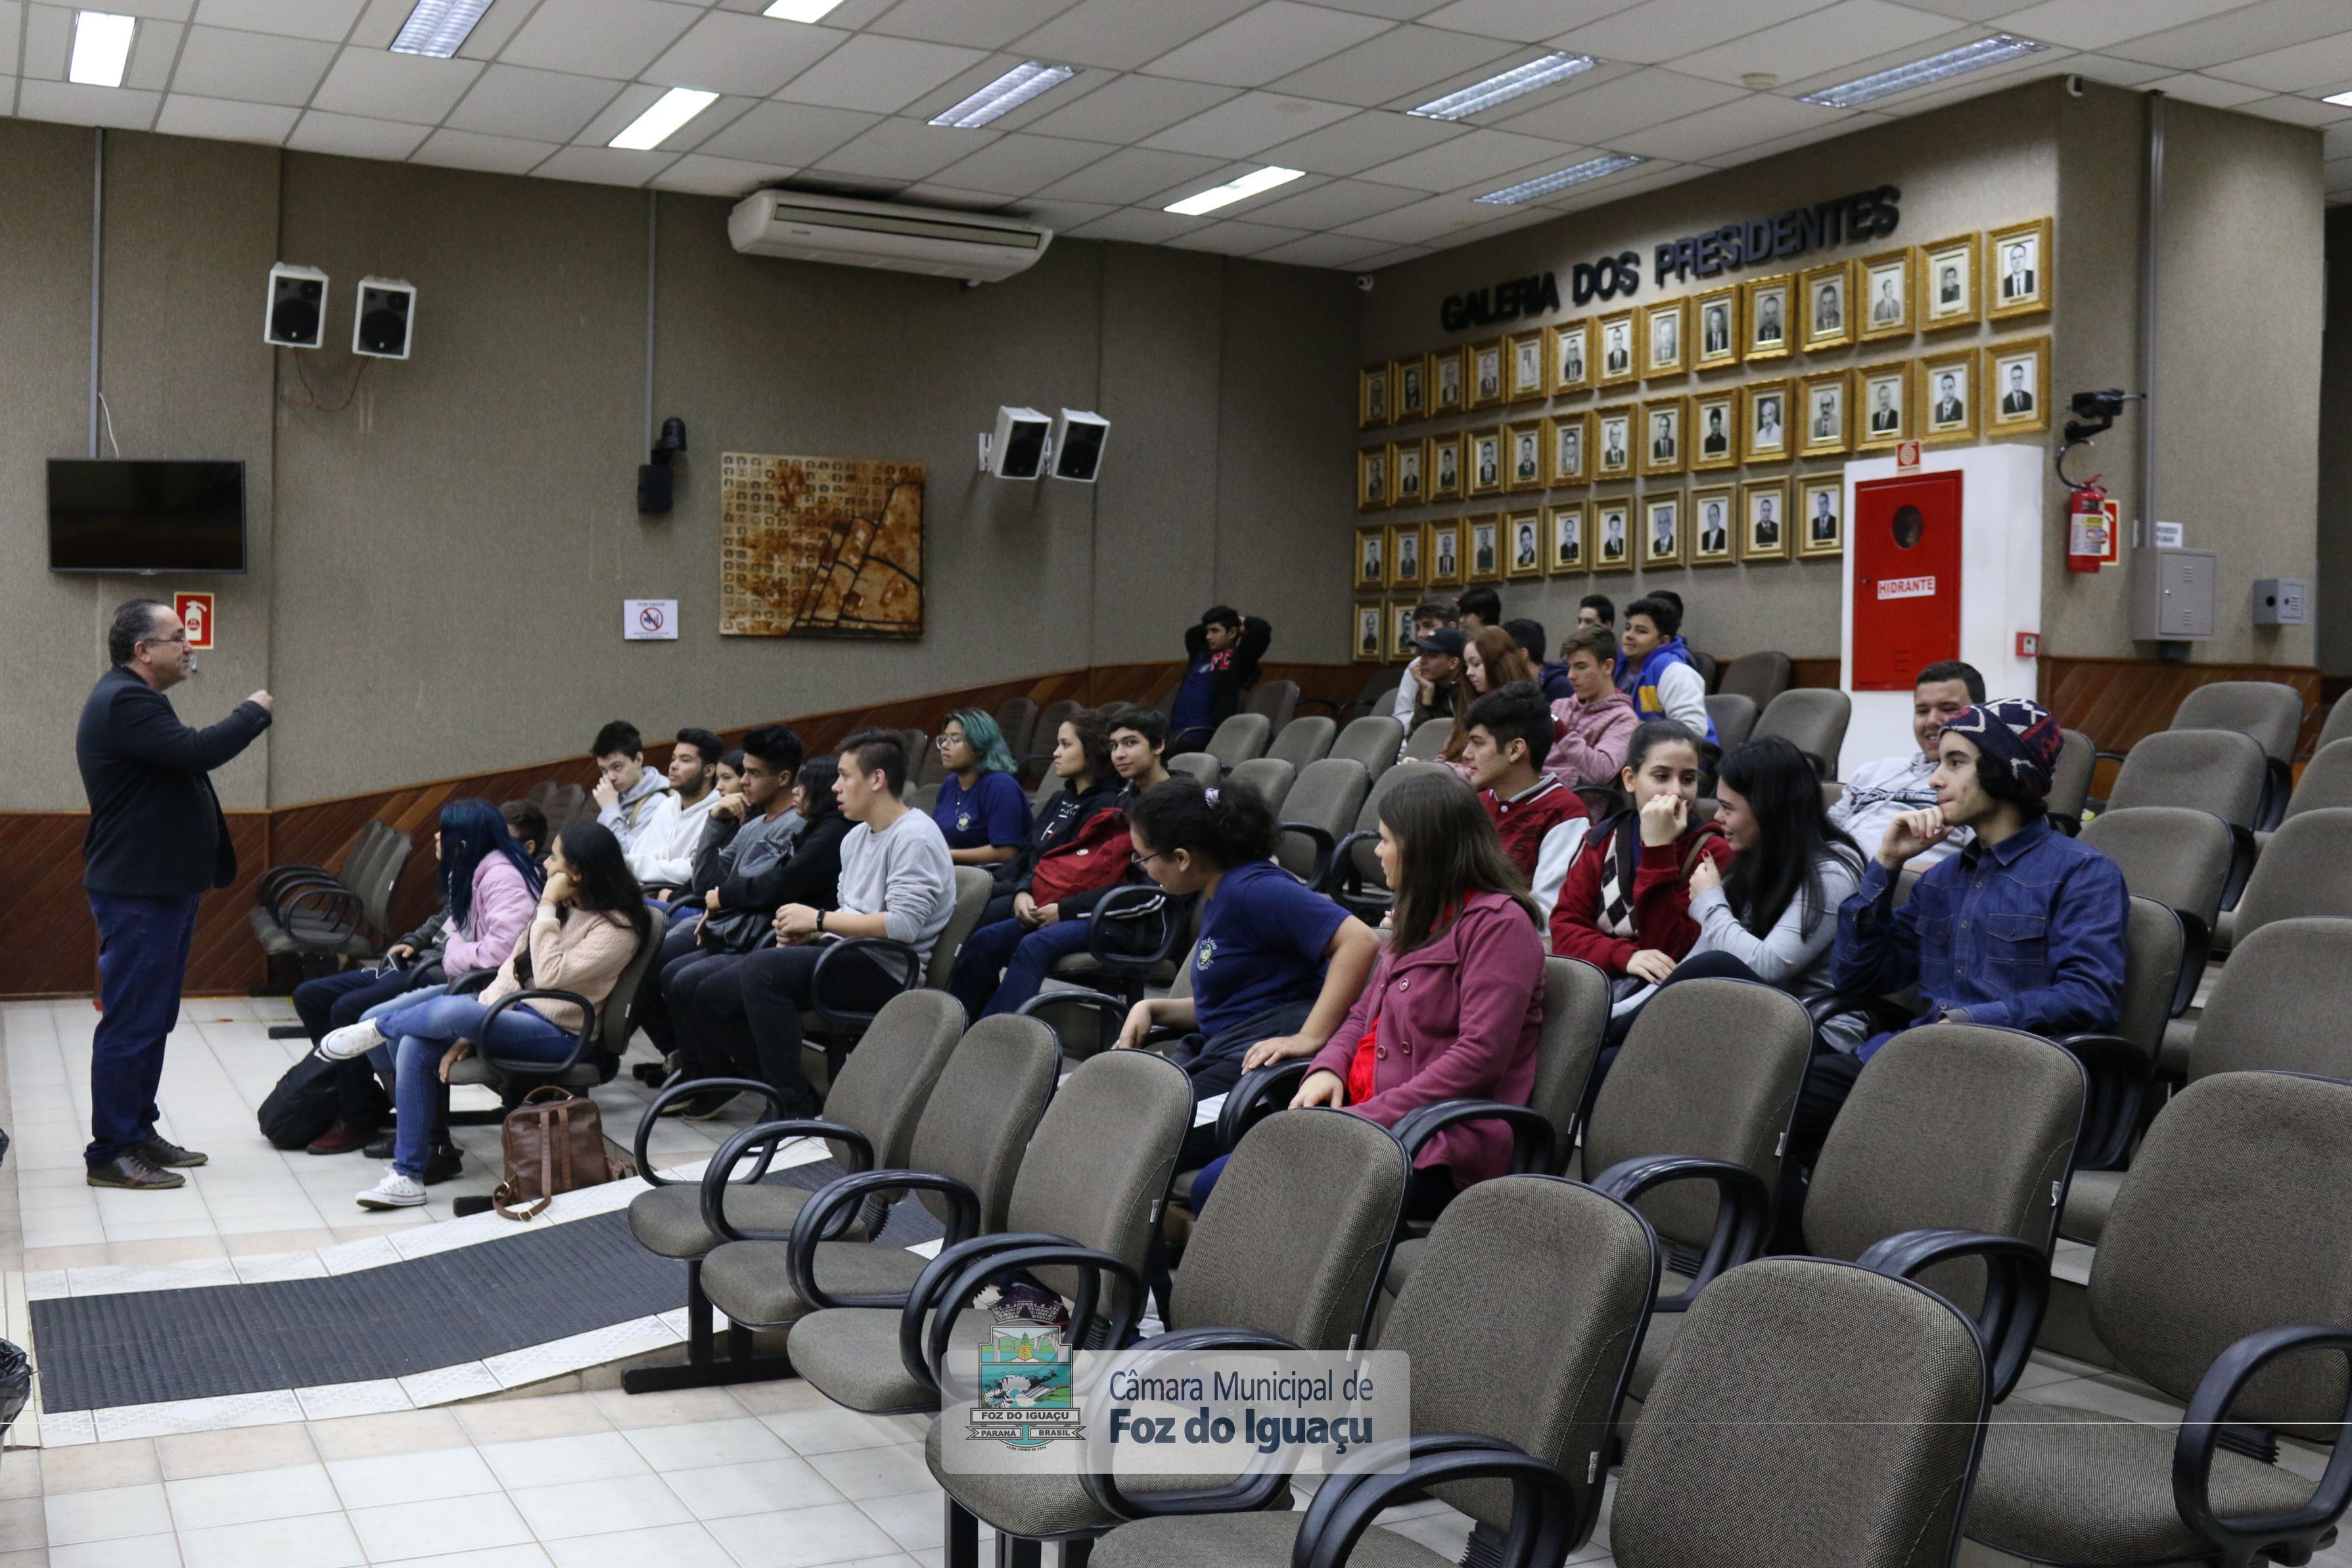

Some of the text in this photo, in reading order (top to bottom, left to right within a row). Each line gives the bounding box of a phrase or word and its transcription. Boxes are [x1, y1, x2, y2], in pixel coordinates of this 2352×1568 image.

[1441, 185, 1901, 331] GALERIA DOS PRESIDENTES
[1879, 578, 1933, 593] HIDRANTE
